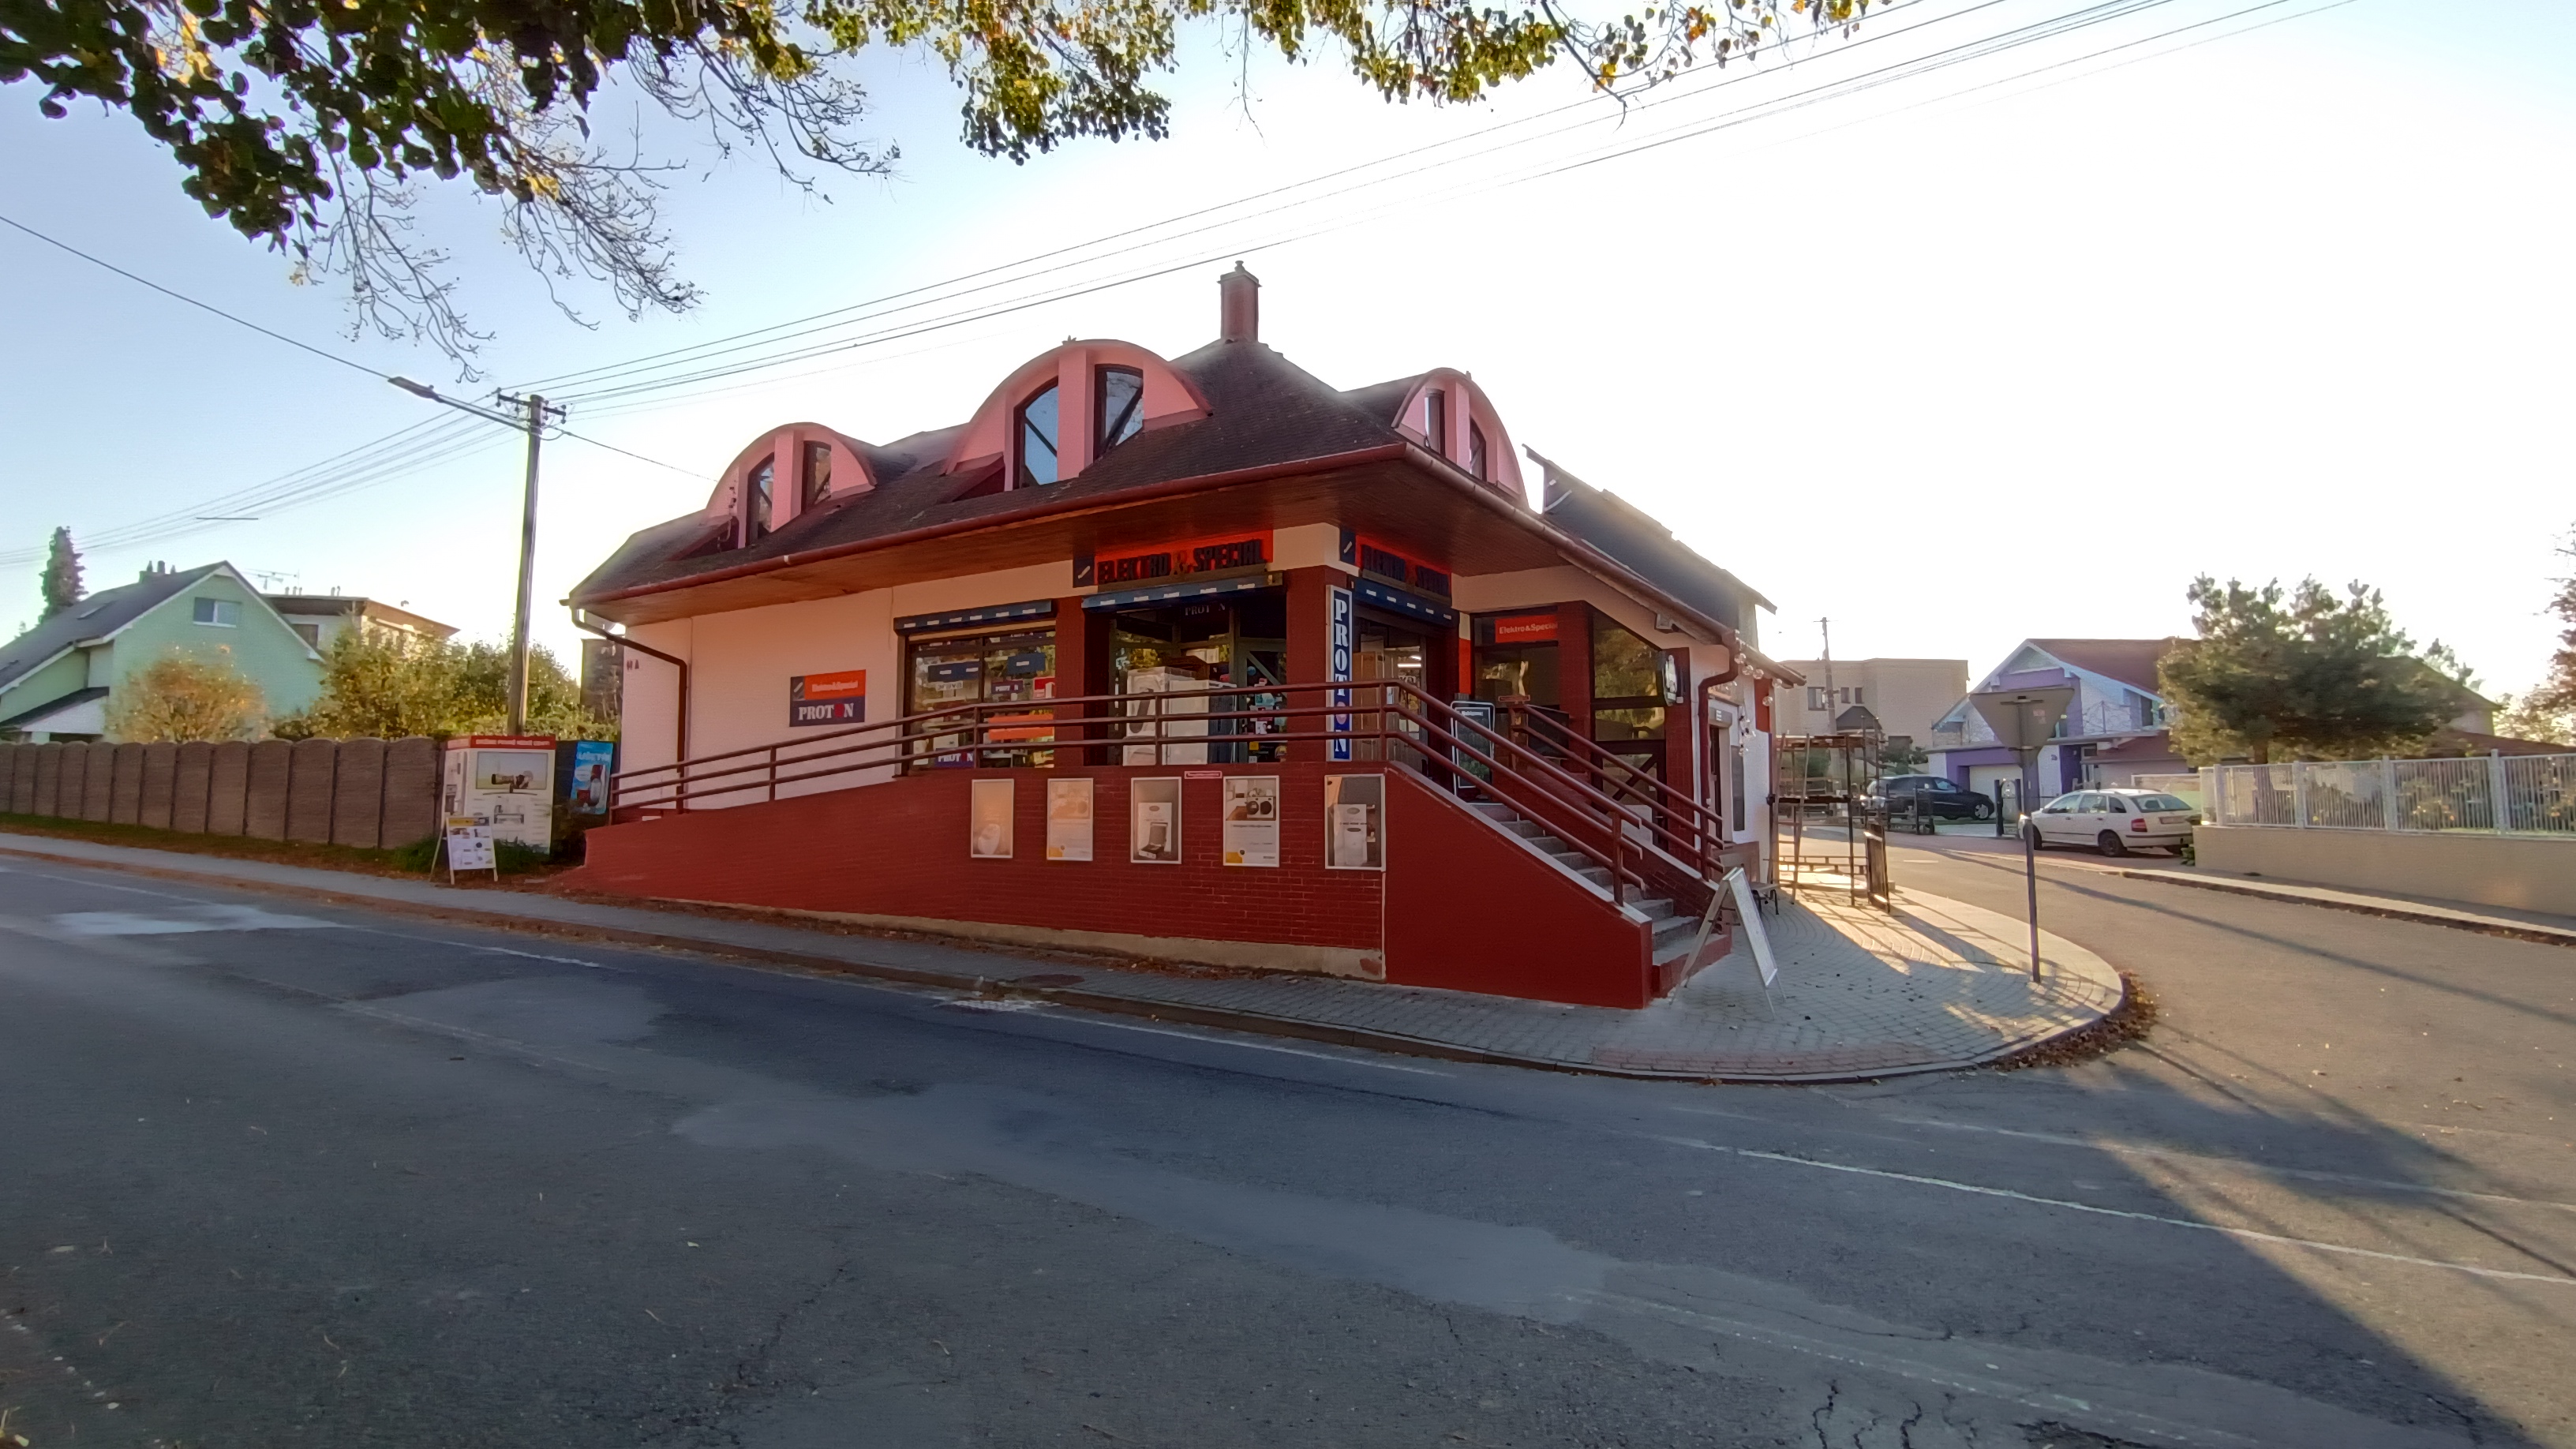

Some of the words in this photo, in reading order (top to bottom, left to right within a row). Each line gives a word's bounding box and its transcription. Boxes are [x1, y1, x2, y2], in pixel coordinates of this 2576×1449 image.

[1097, 552, 1171, 584] ELEKTRO
[1193, 538, 1267, 572] SPECIAL
[1185, 603, 1226, 616] PROTN
